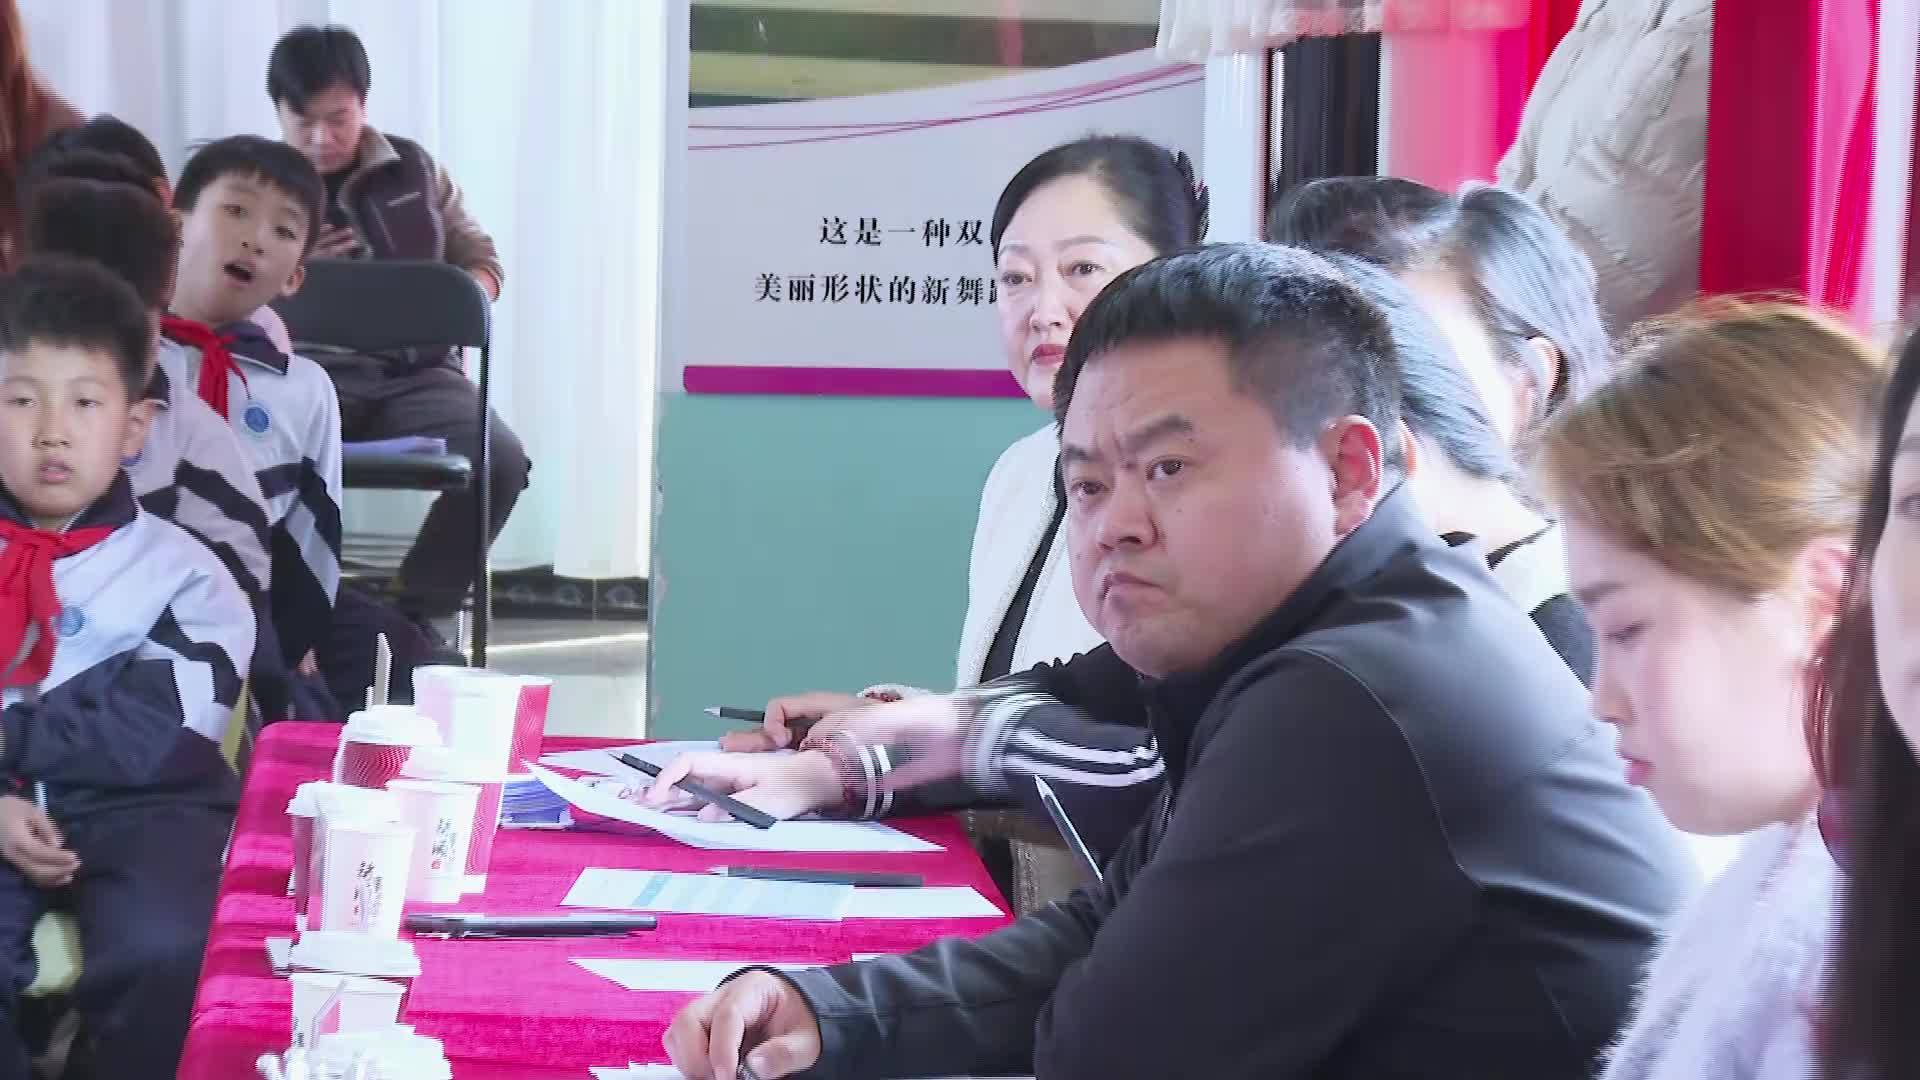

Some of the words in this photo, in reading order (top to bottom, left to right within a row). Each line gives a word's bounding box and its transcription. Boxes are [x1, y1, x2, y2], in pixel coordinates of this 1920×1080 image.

[819, 216, 984, 248] 这是一种双
